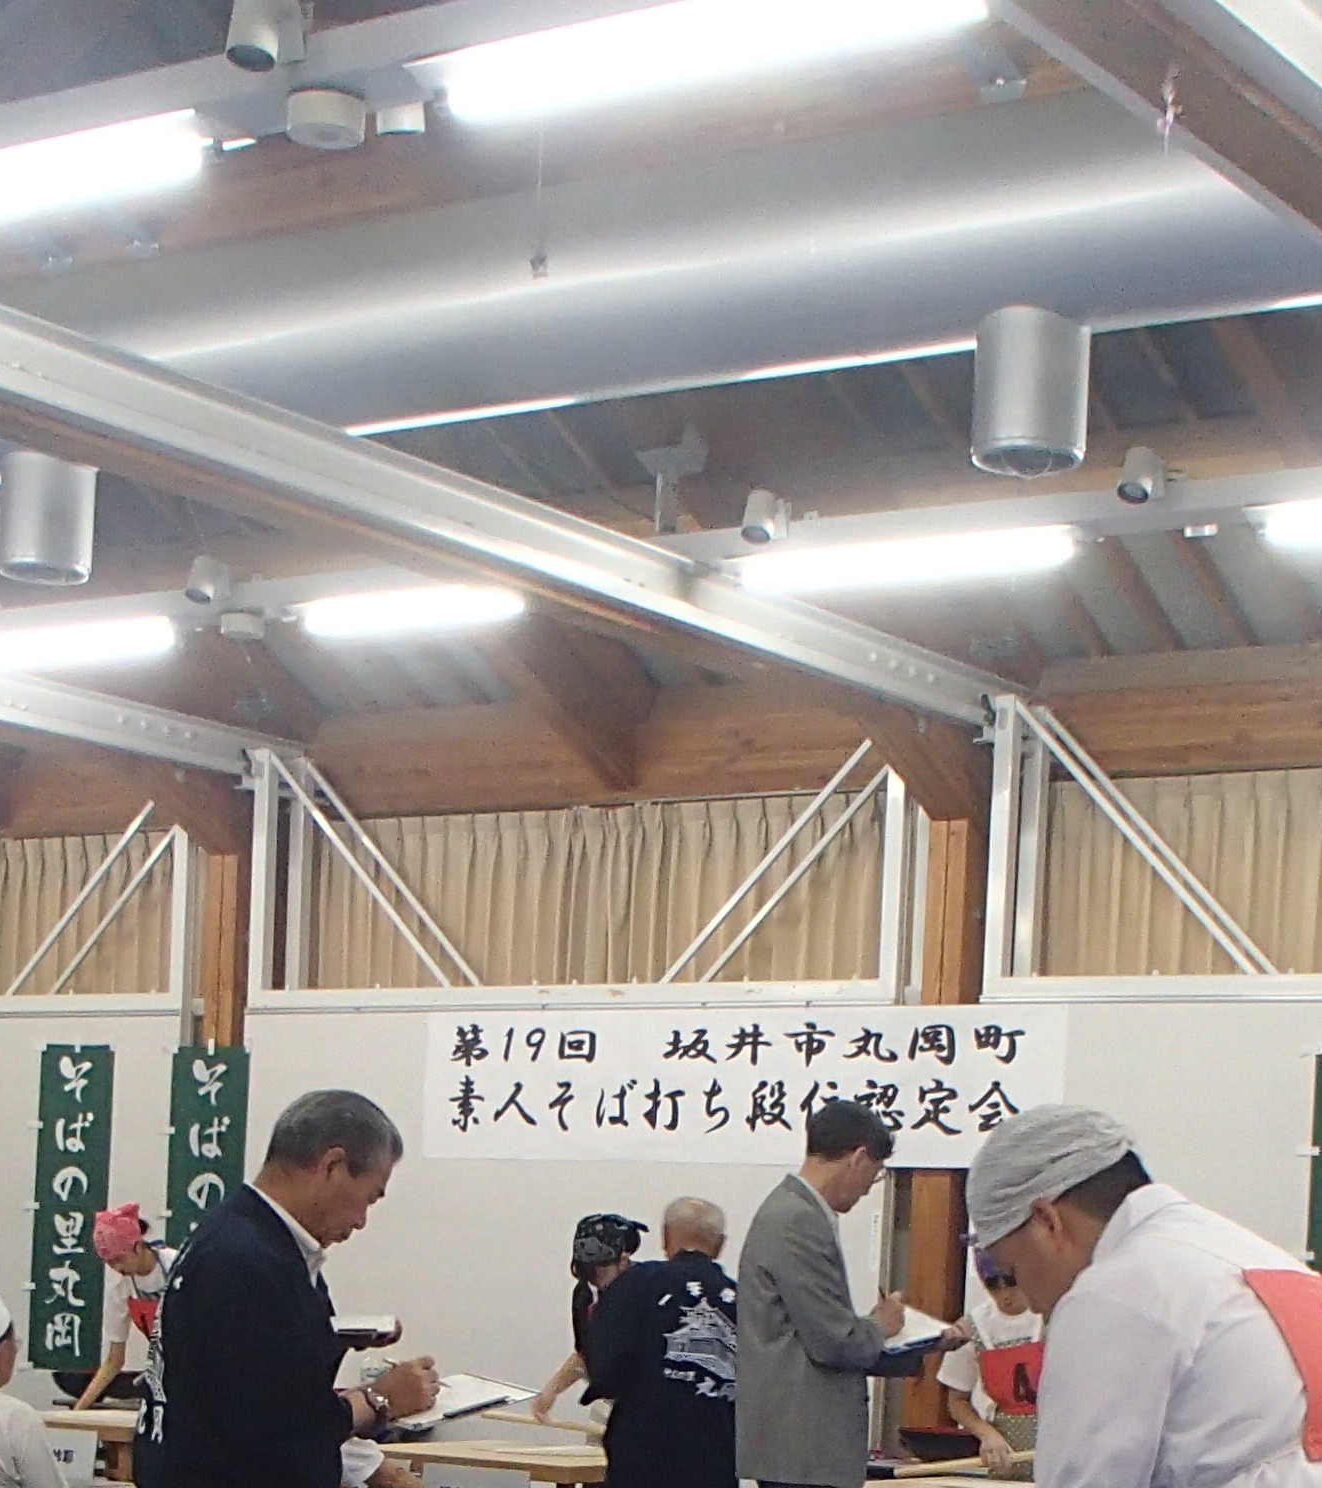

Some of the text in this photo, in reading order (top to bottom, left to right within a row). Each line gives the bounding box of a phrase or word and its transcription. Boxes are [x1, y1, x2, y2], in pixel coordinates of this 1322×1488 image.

[450, 1021, 1027, 1068] 第19回 坂井市丸岡町
[44, 1055, 95, 1358] そばの里丸岡
[186, 1058, 231, 1211] そばの
